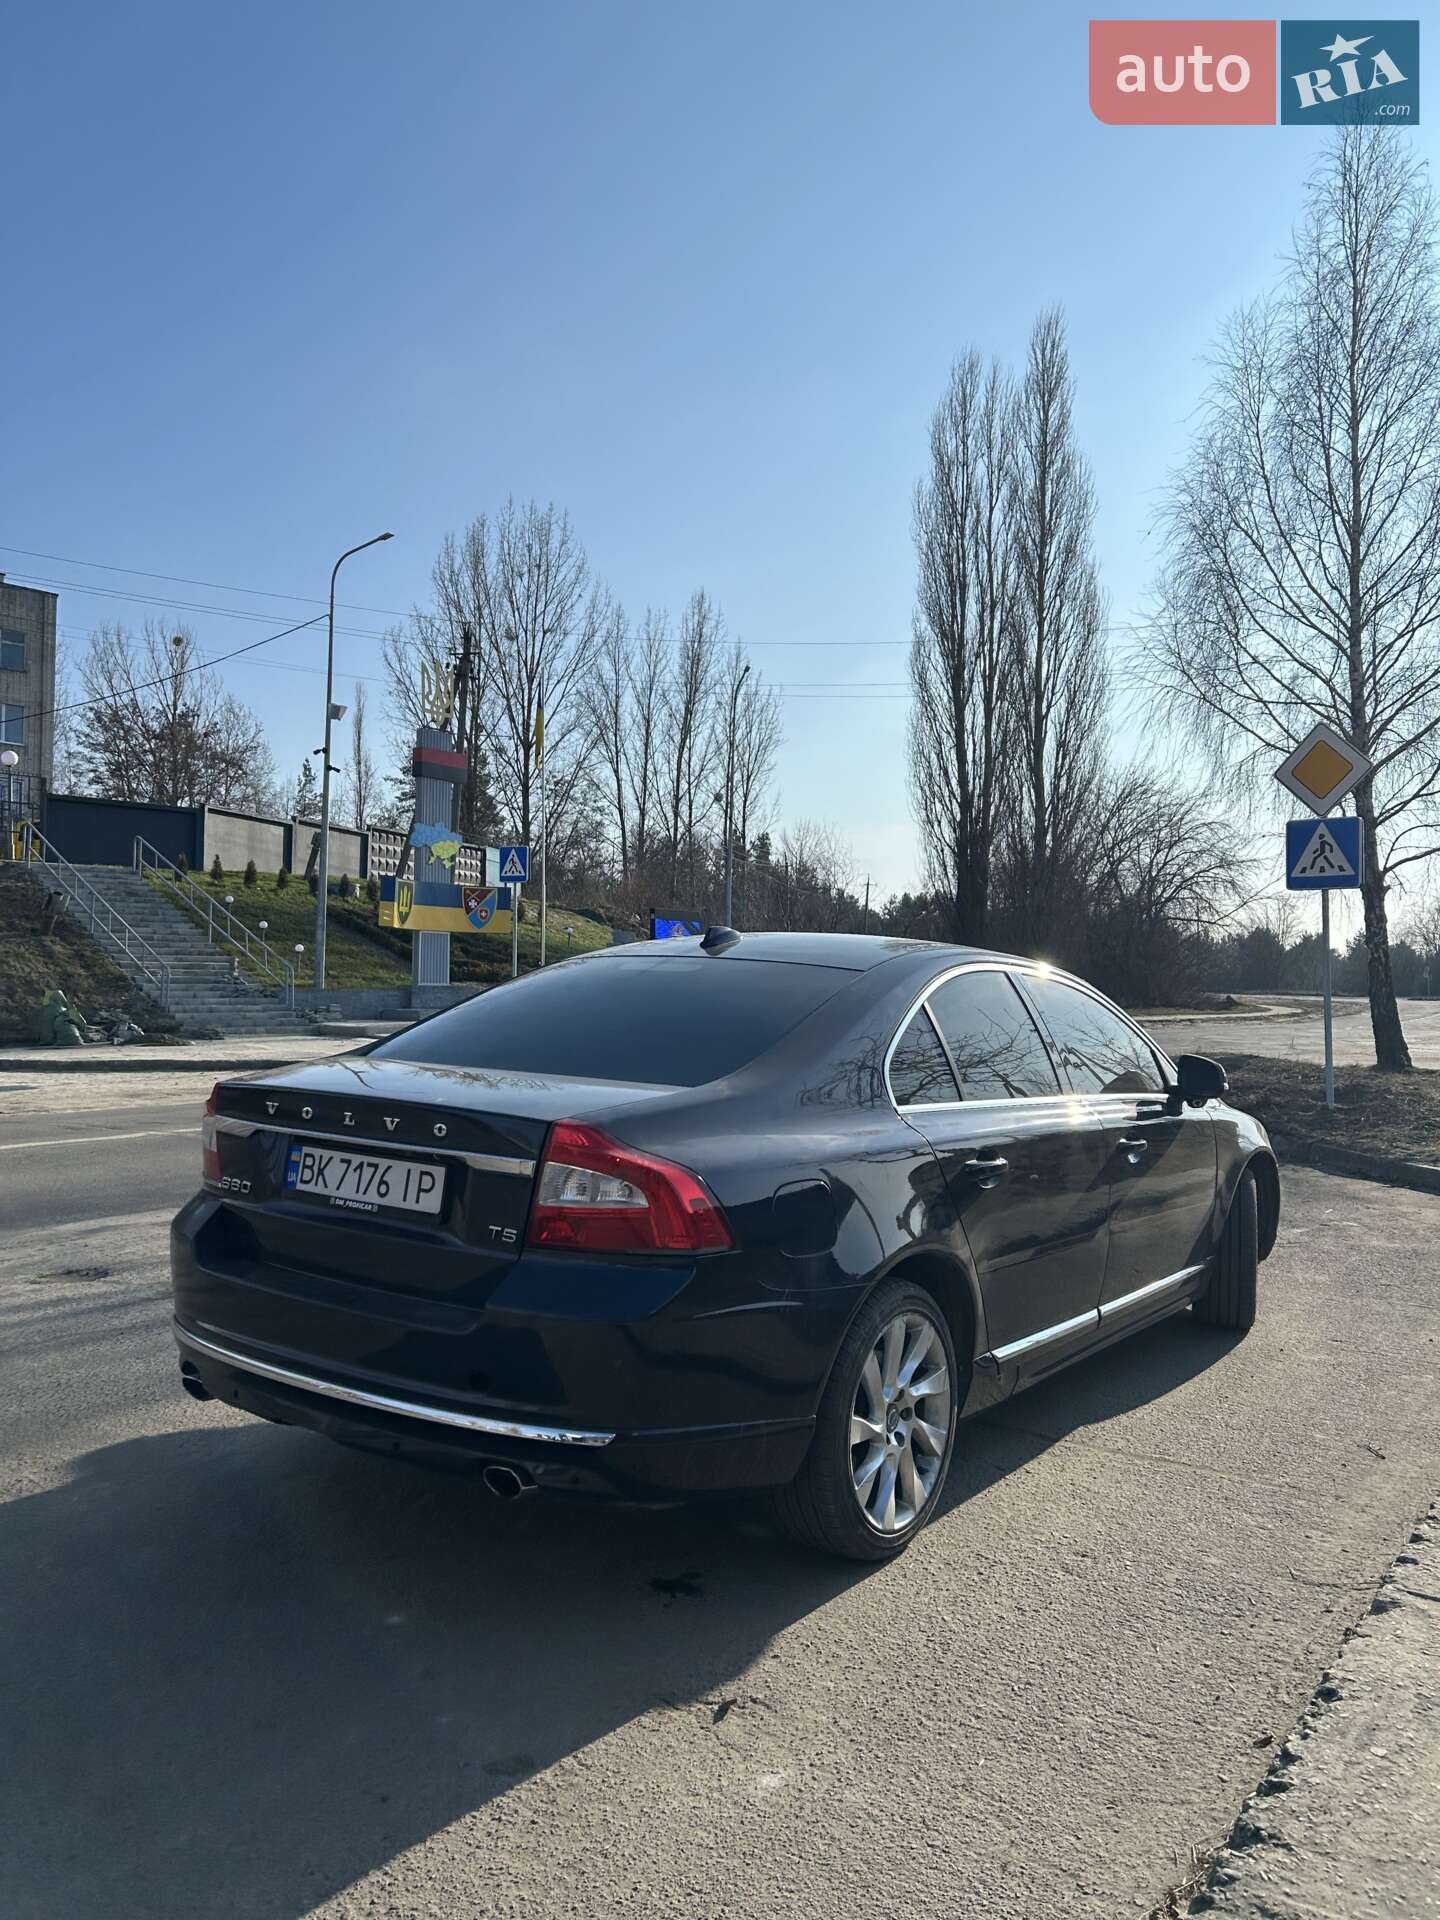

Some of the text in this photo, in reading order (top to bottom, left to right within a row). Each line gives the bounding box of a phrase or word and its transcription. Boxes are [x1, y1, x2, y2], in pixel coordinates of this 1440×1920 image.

[265, 1102, 448, 1137] VOLVO
[300, 1153, 436, 1204] BK 7176 IP
[489, 1225, 518, 1243] T5
